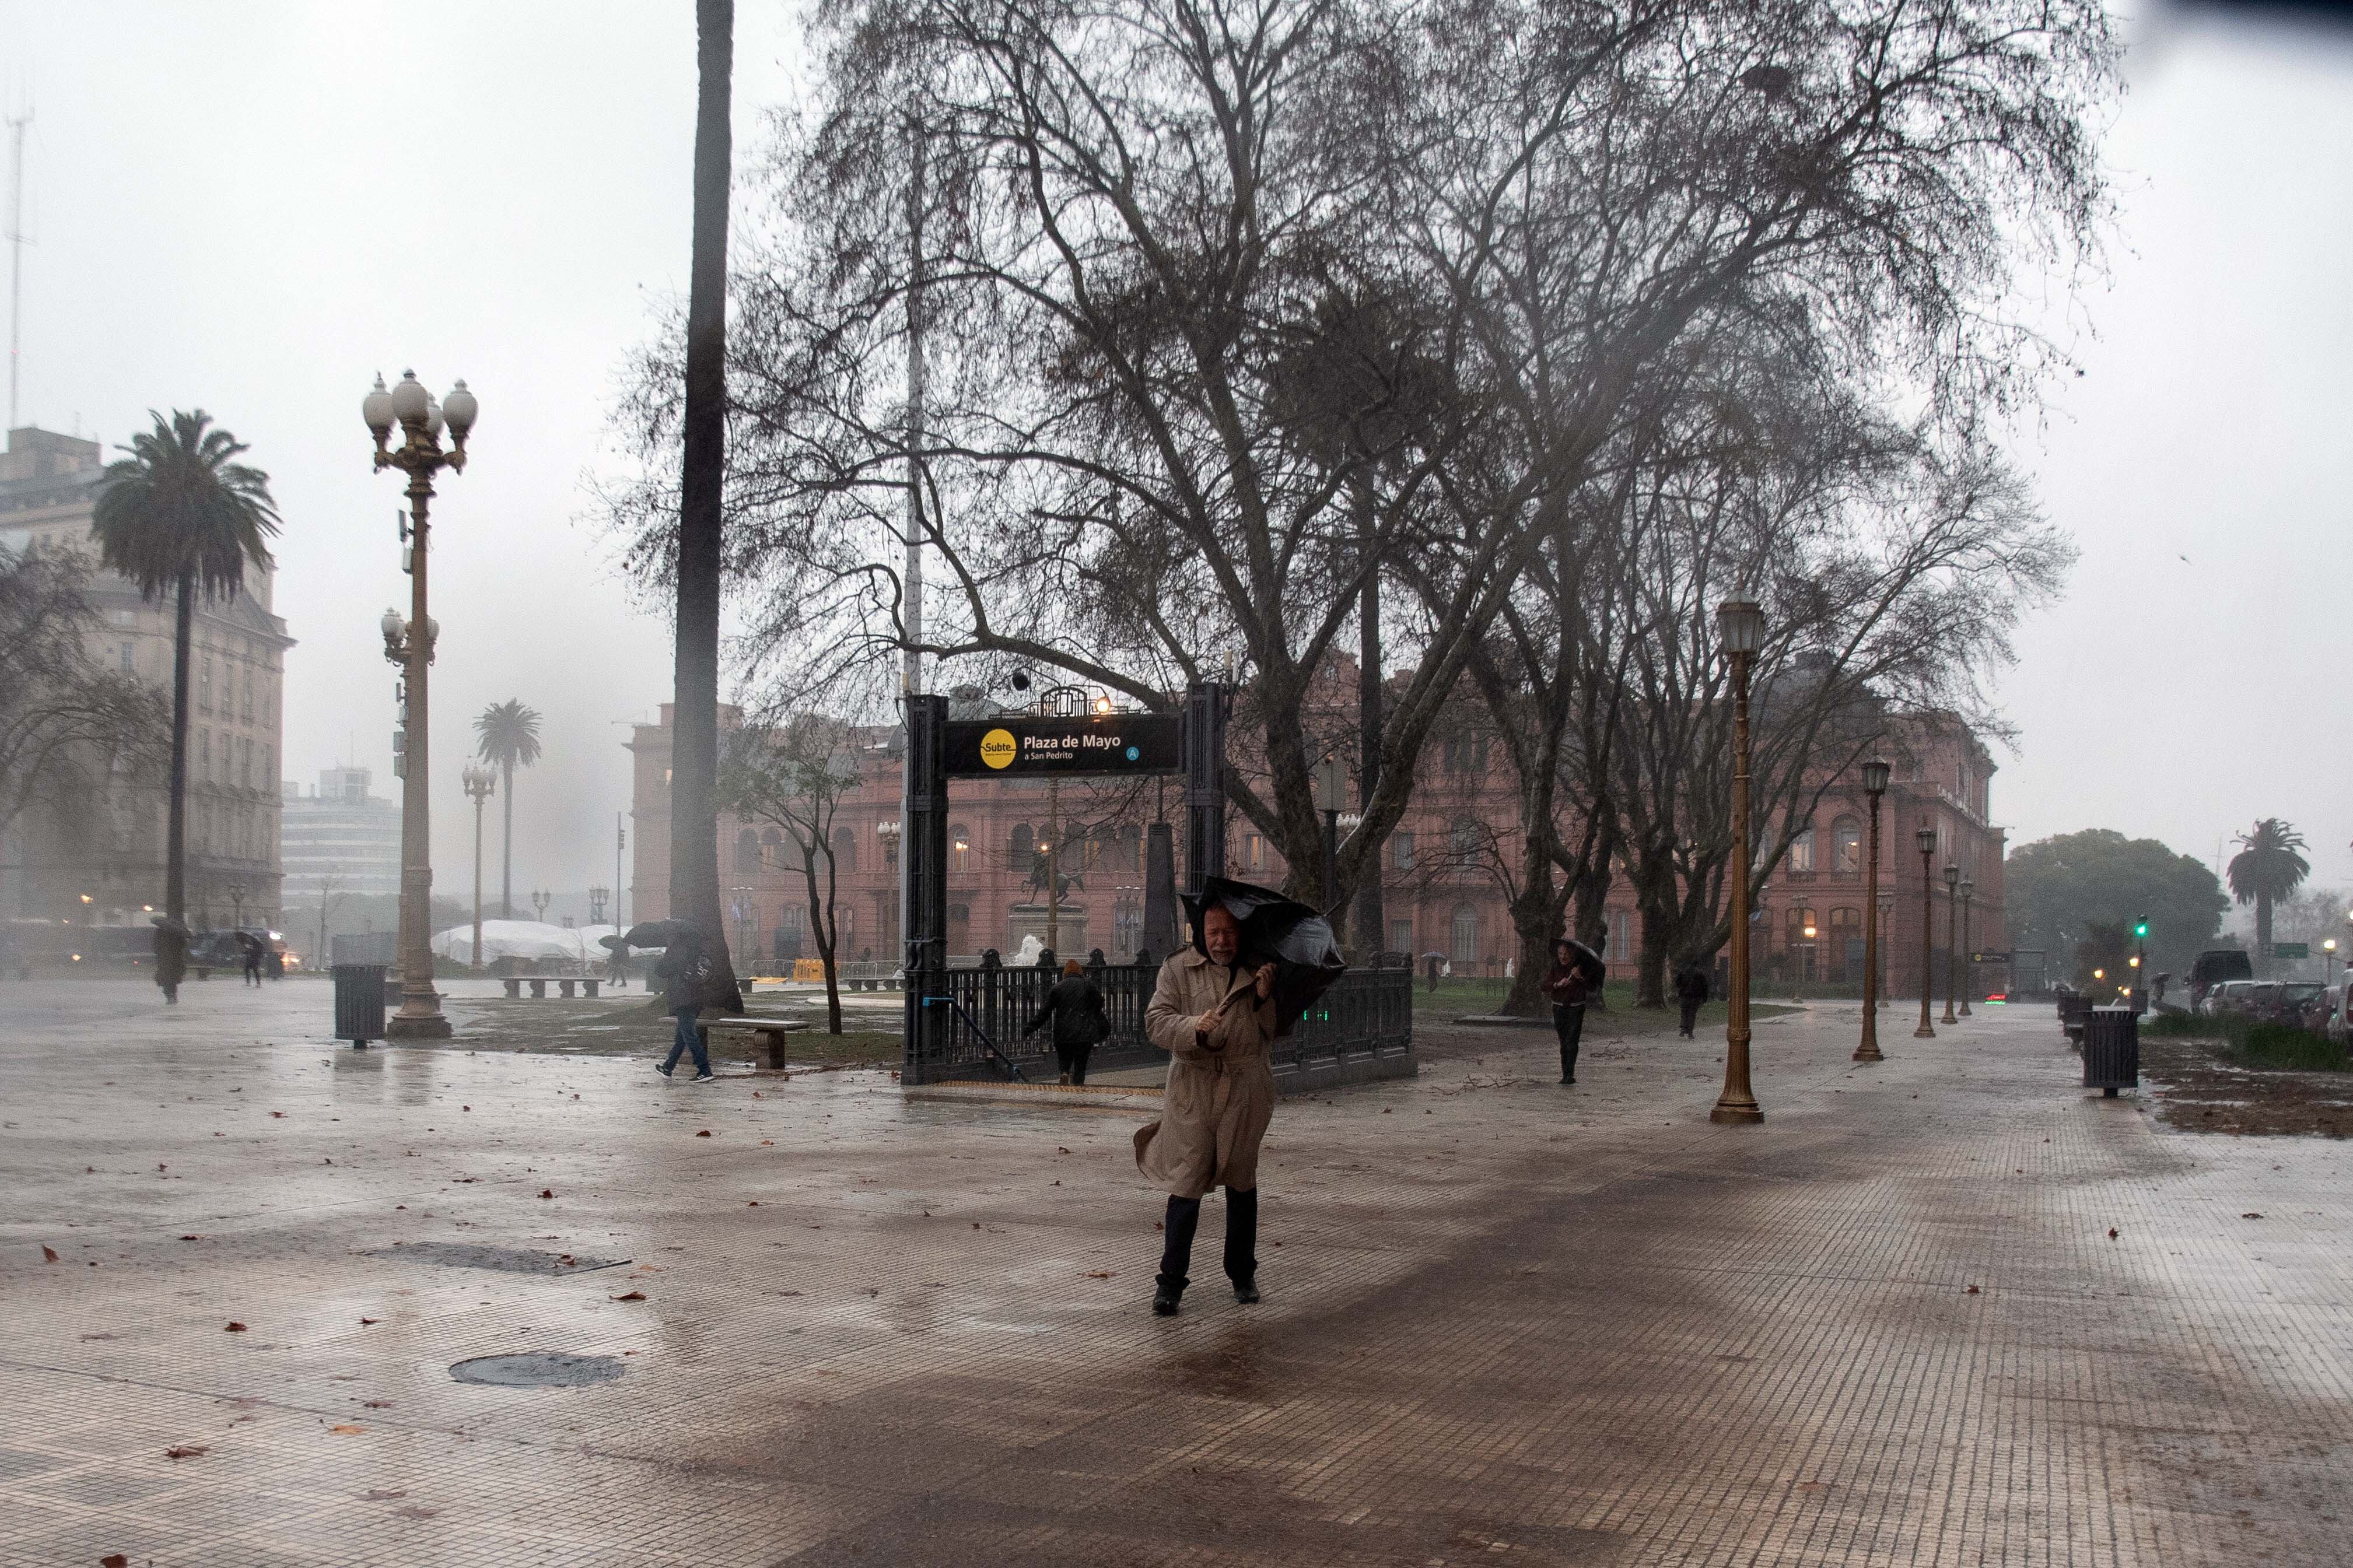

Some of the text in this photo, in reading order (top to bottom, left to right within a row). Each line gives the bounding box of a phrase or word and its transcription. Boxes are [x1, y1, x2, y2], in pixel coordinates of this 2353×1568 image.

[985, 742, 1011, 752] Subte
[1024, 735, 1121, 750] Plaza de Mayo
[1031, 752, 1044, 760] San
[1046, 751, 1074, 760] Pedrito
[1129, 749, 1137, 758] A
